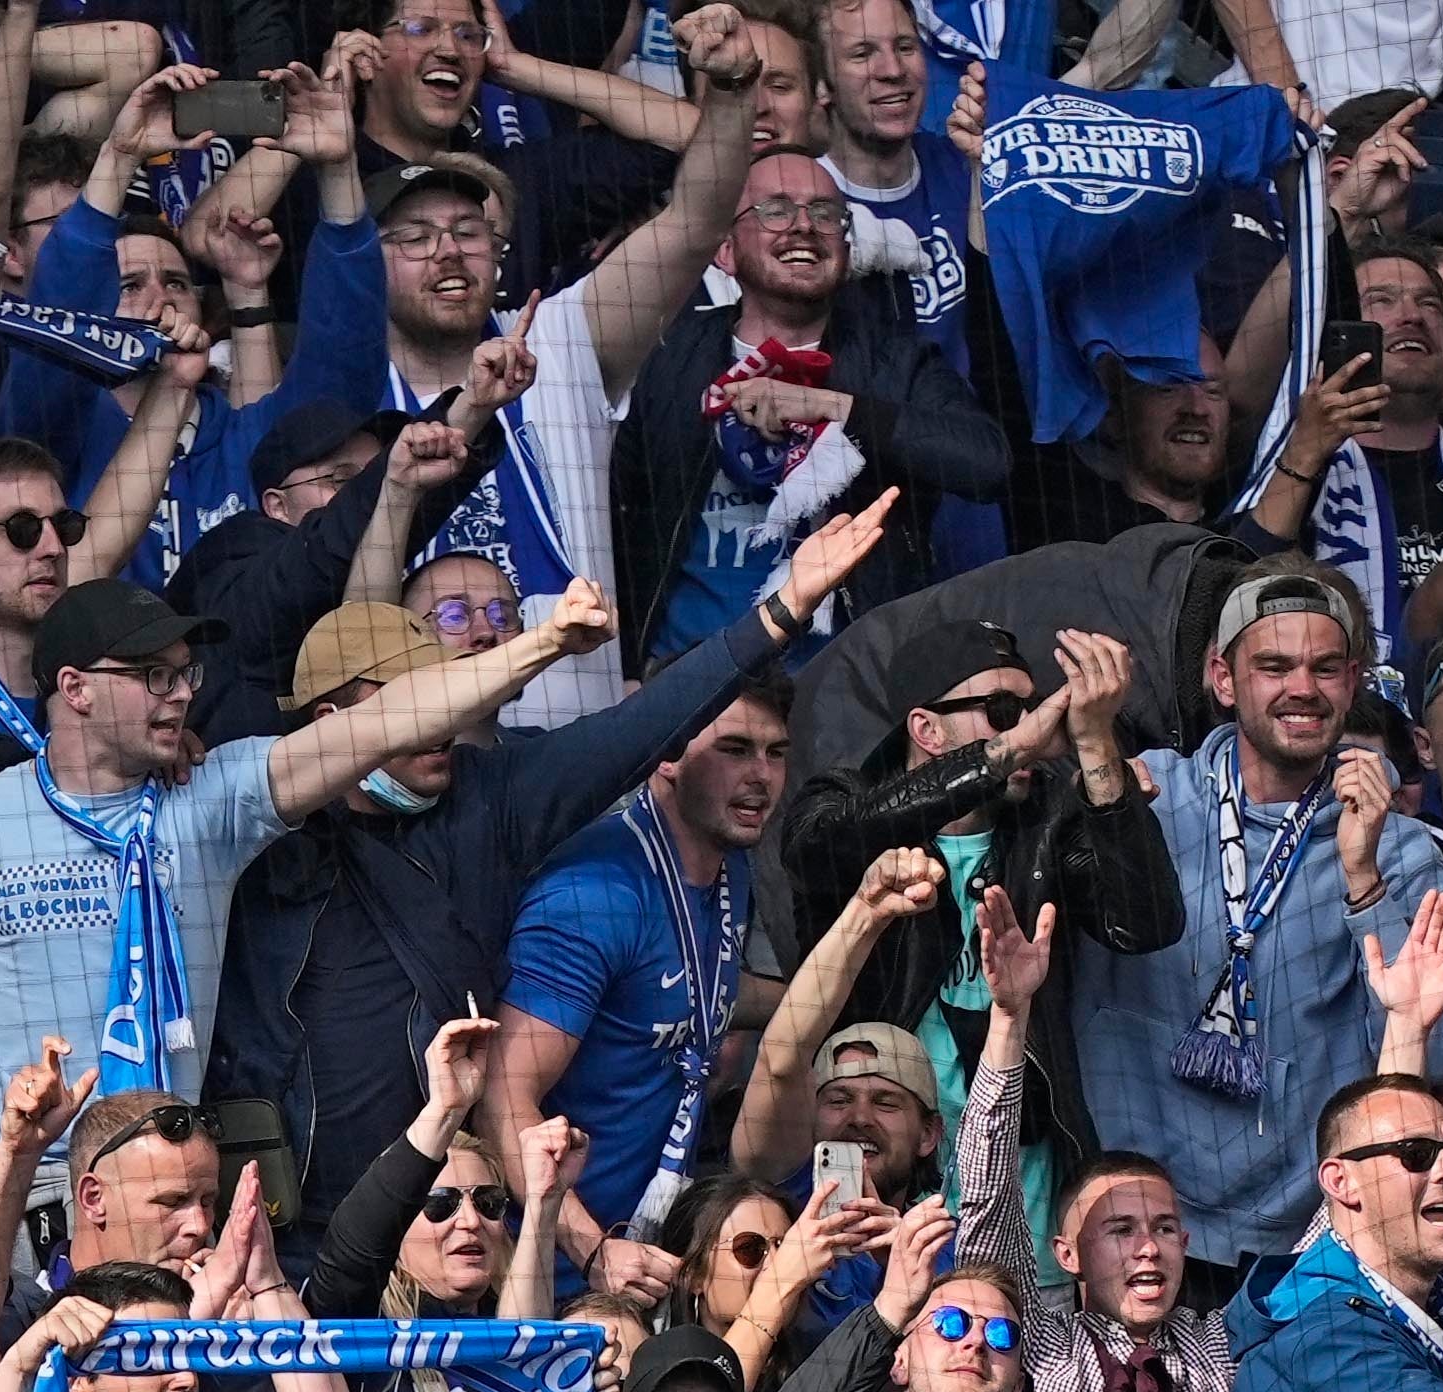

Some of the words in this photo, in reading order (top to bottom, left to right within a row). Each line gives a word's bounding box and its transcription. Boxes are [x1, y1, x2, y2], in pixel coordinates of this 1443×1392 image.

[981, 123, 1041, 165] WIR
[1044, 122, 1190, 150] BLEIBEN
[1021, 144, 1152, 180] DRIN!
[20, 896, 111, 920] BOCHUM
[80, 1320, 345, 1373] zurück
[390, 1320, 463, 1370] in
